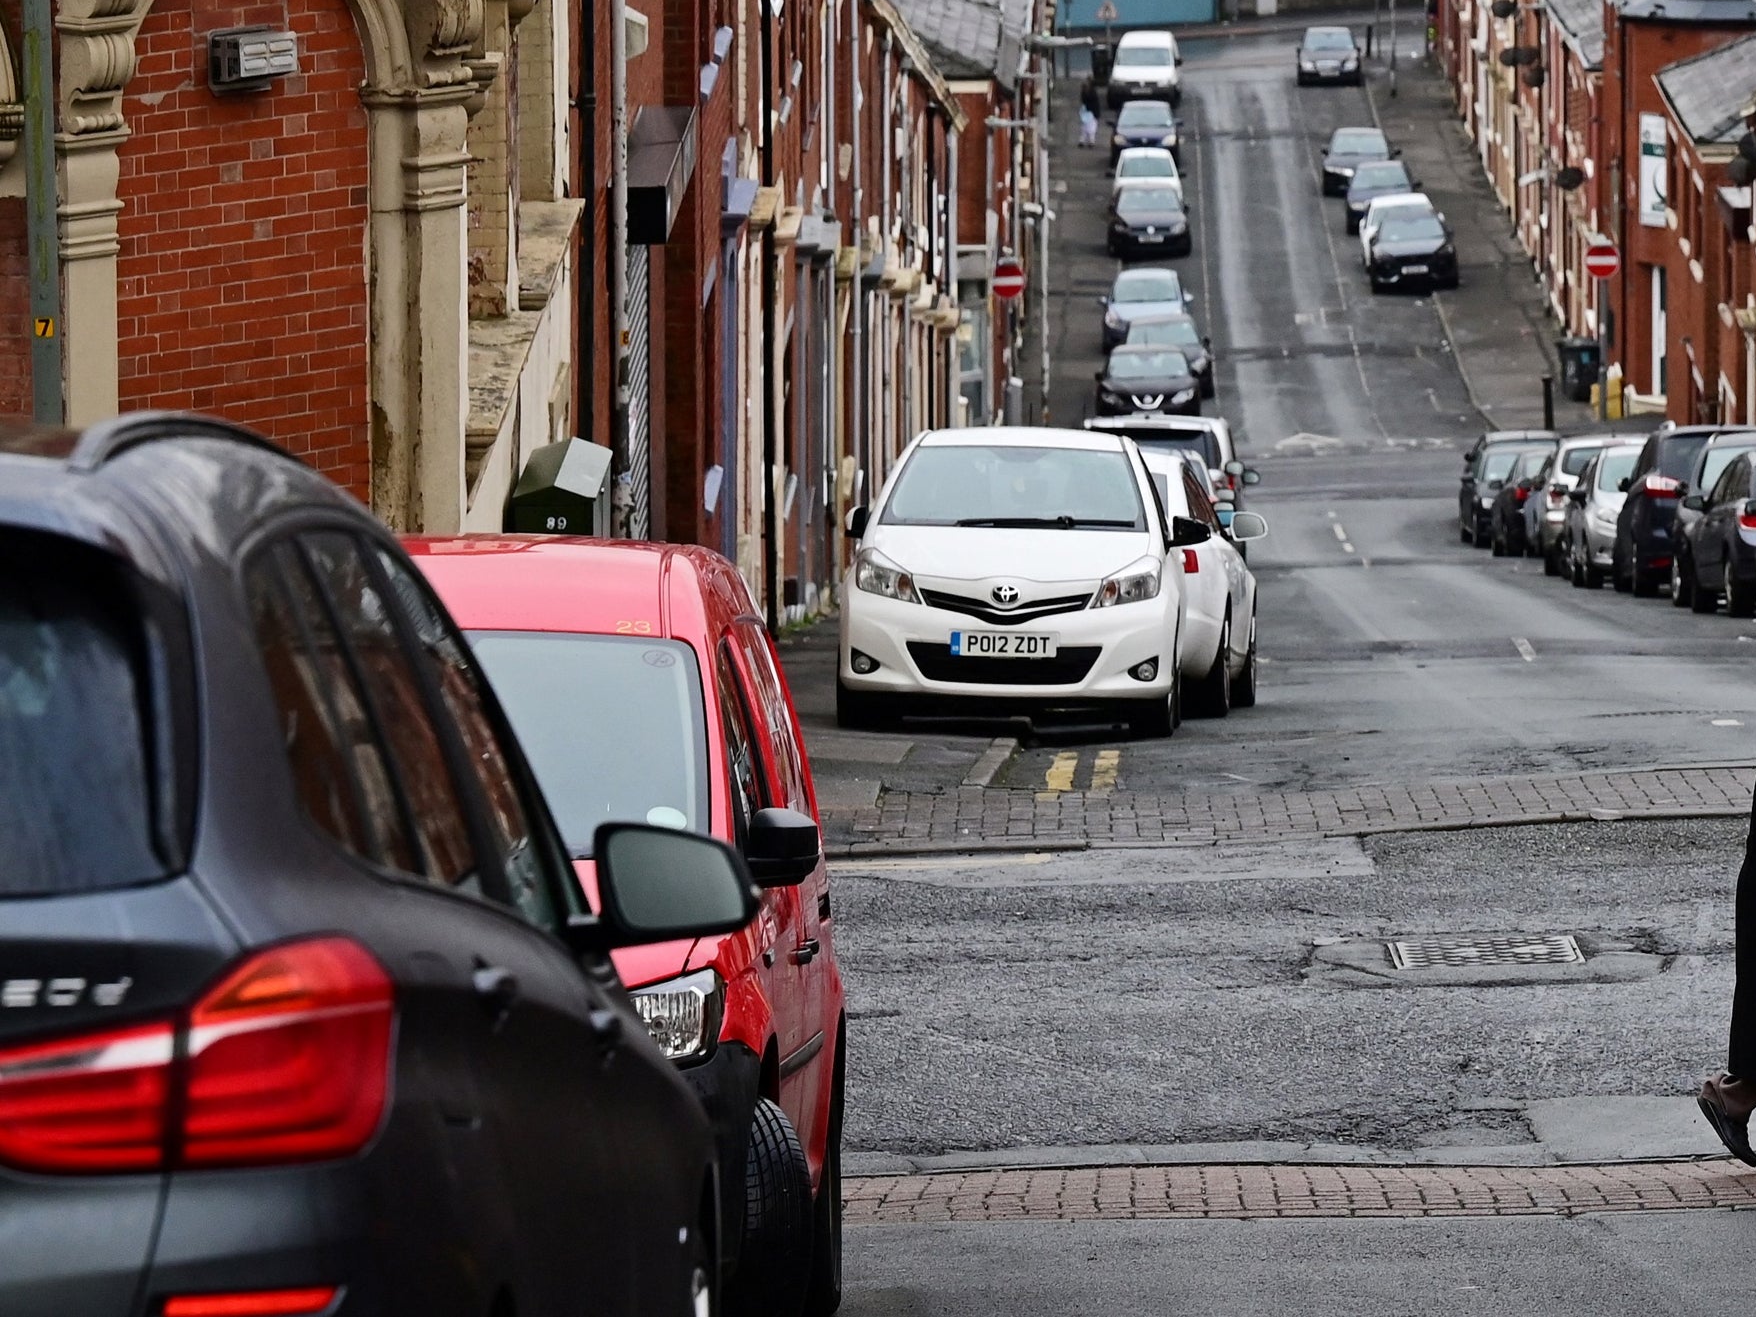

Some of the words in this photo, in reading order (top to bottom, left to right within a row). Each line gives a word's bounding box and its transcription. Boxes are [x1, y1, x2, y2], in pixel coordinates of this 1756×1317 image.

[38, 319, 49, 336] 7
[546, 516, 567, 530] 89
[616, 620, 651, 634] 23
[966, 635, 1009, 653] PO12
[1014, 636, 1051, 654] ZDT
